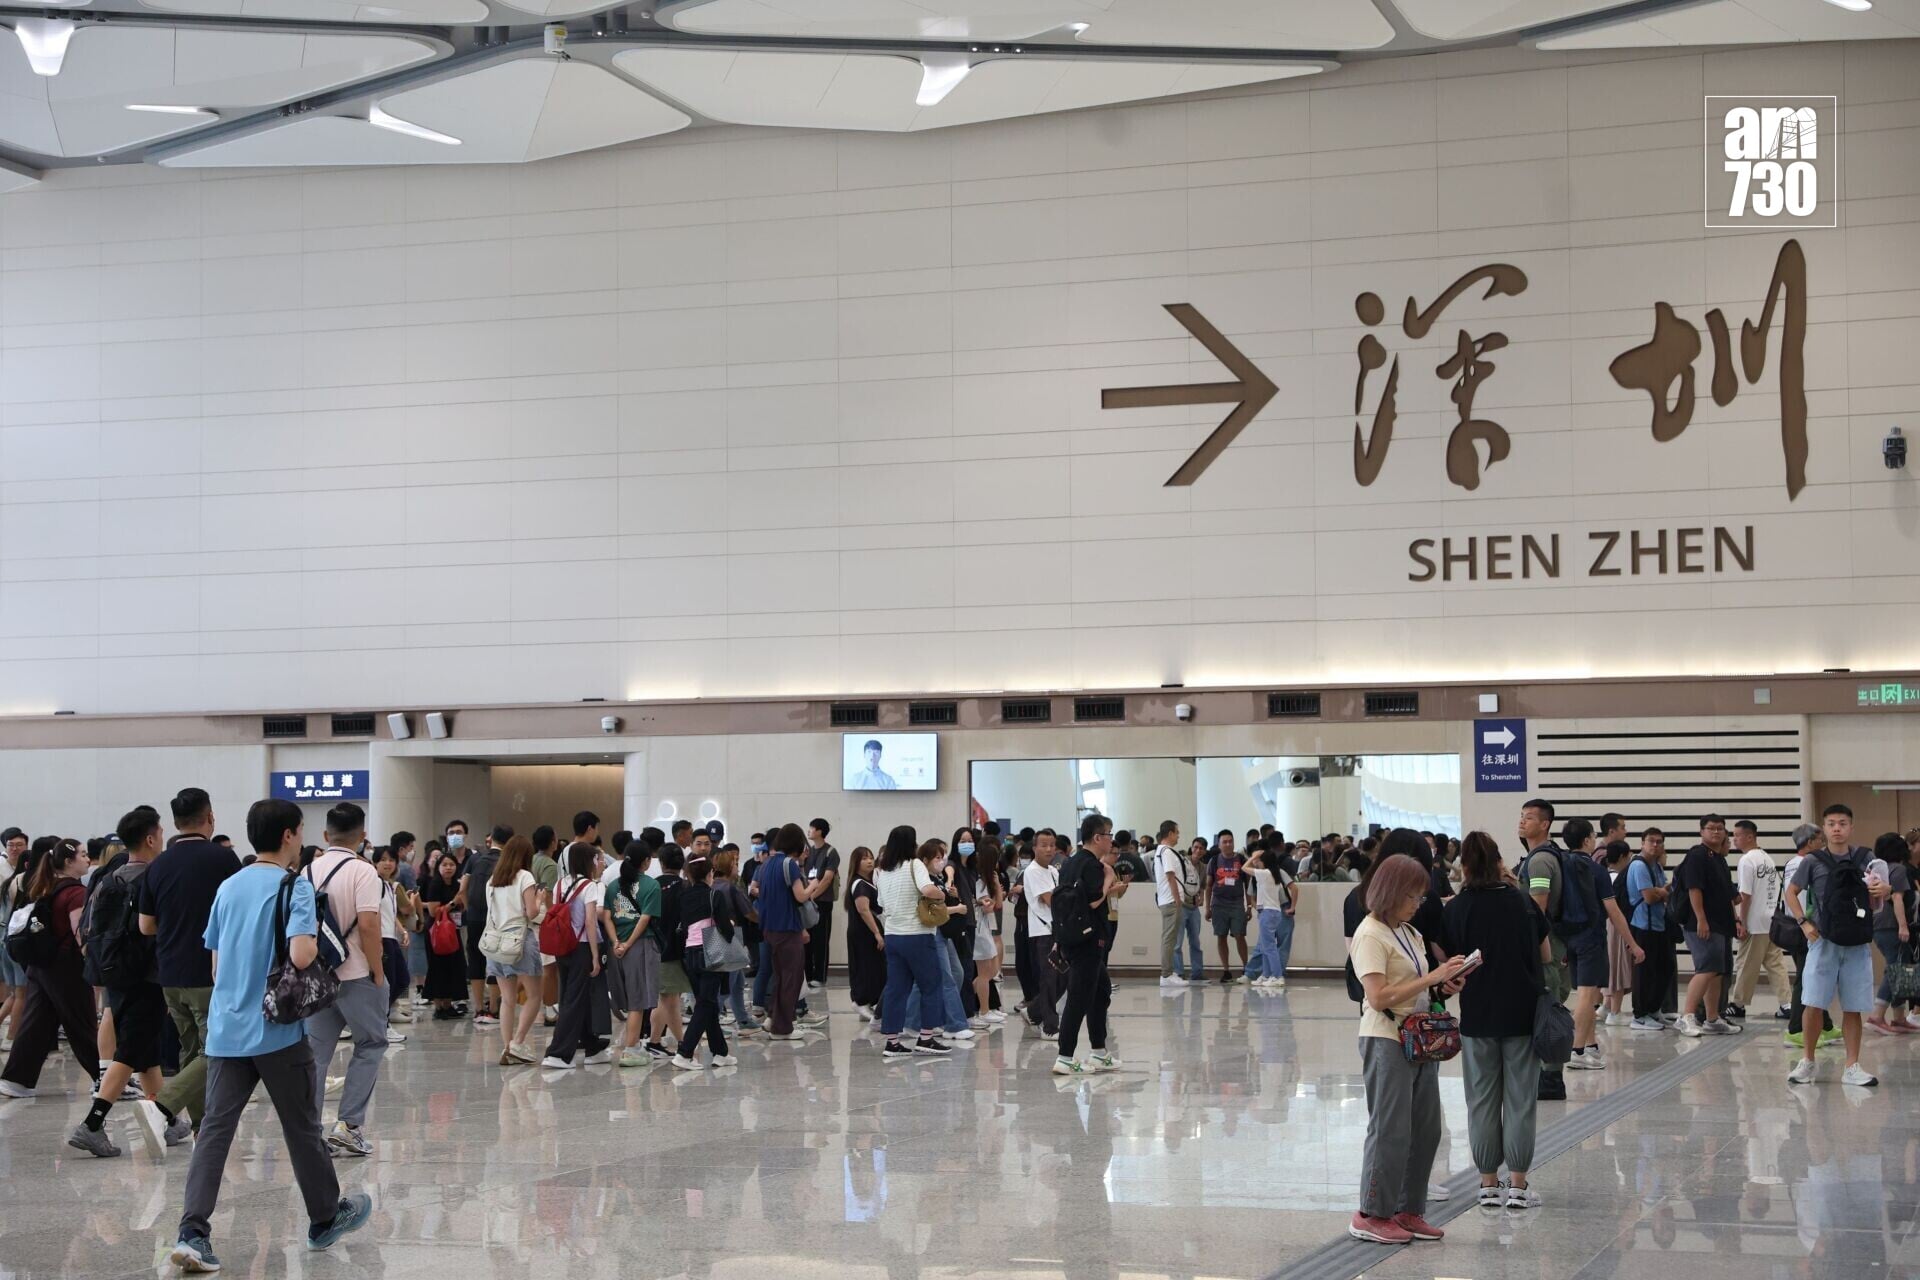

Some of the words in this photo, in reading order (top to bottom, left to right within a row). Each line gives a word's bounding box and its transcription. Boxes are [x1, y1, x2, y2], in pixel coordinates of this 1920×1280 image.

[1408, 534, 1560, 582] SHEN
[1588, 526, 1755, 577] ZHEN
[1858, 690, 1879, 700] 出口
[1904, 689, 1920, 700] EXI
[1481, 753, 1519, 766] 往深圳
[296, 789, 312, 798] Staff
[314, 788, 342, 797] Channel
